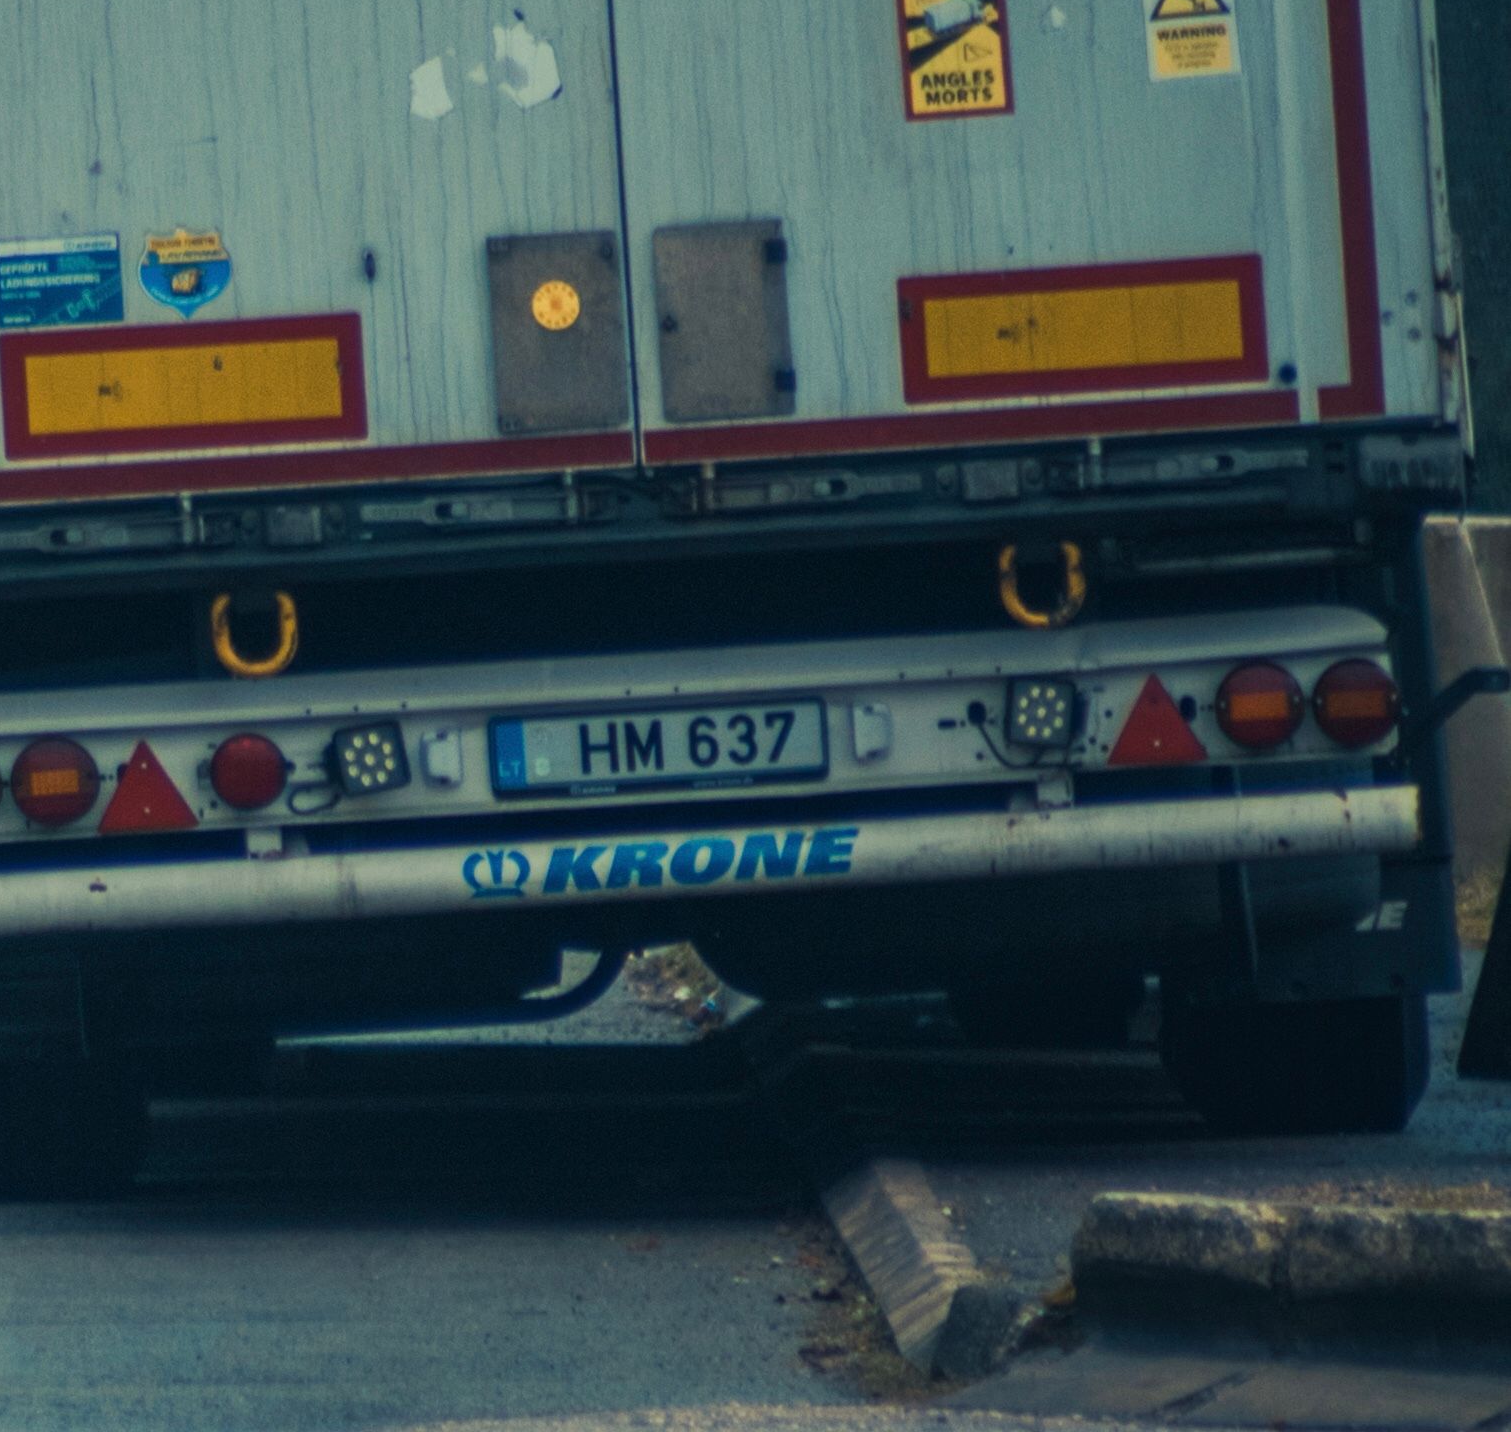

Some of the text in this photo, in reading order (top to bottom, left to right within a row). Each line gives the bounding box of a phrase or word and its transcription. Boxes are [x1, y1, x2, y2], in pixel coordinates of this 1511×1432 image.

[1157, 23, 1226, 42] WARNING
[921, 70, 994, 89] ANGLES
[925, 88, 993, 106] MORTS
[579, 711, 796, 775] HM 637
[498, 759, 522, 779] LT
[542, 826, 859, 895] KRONE
